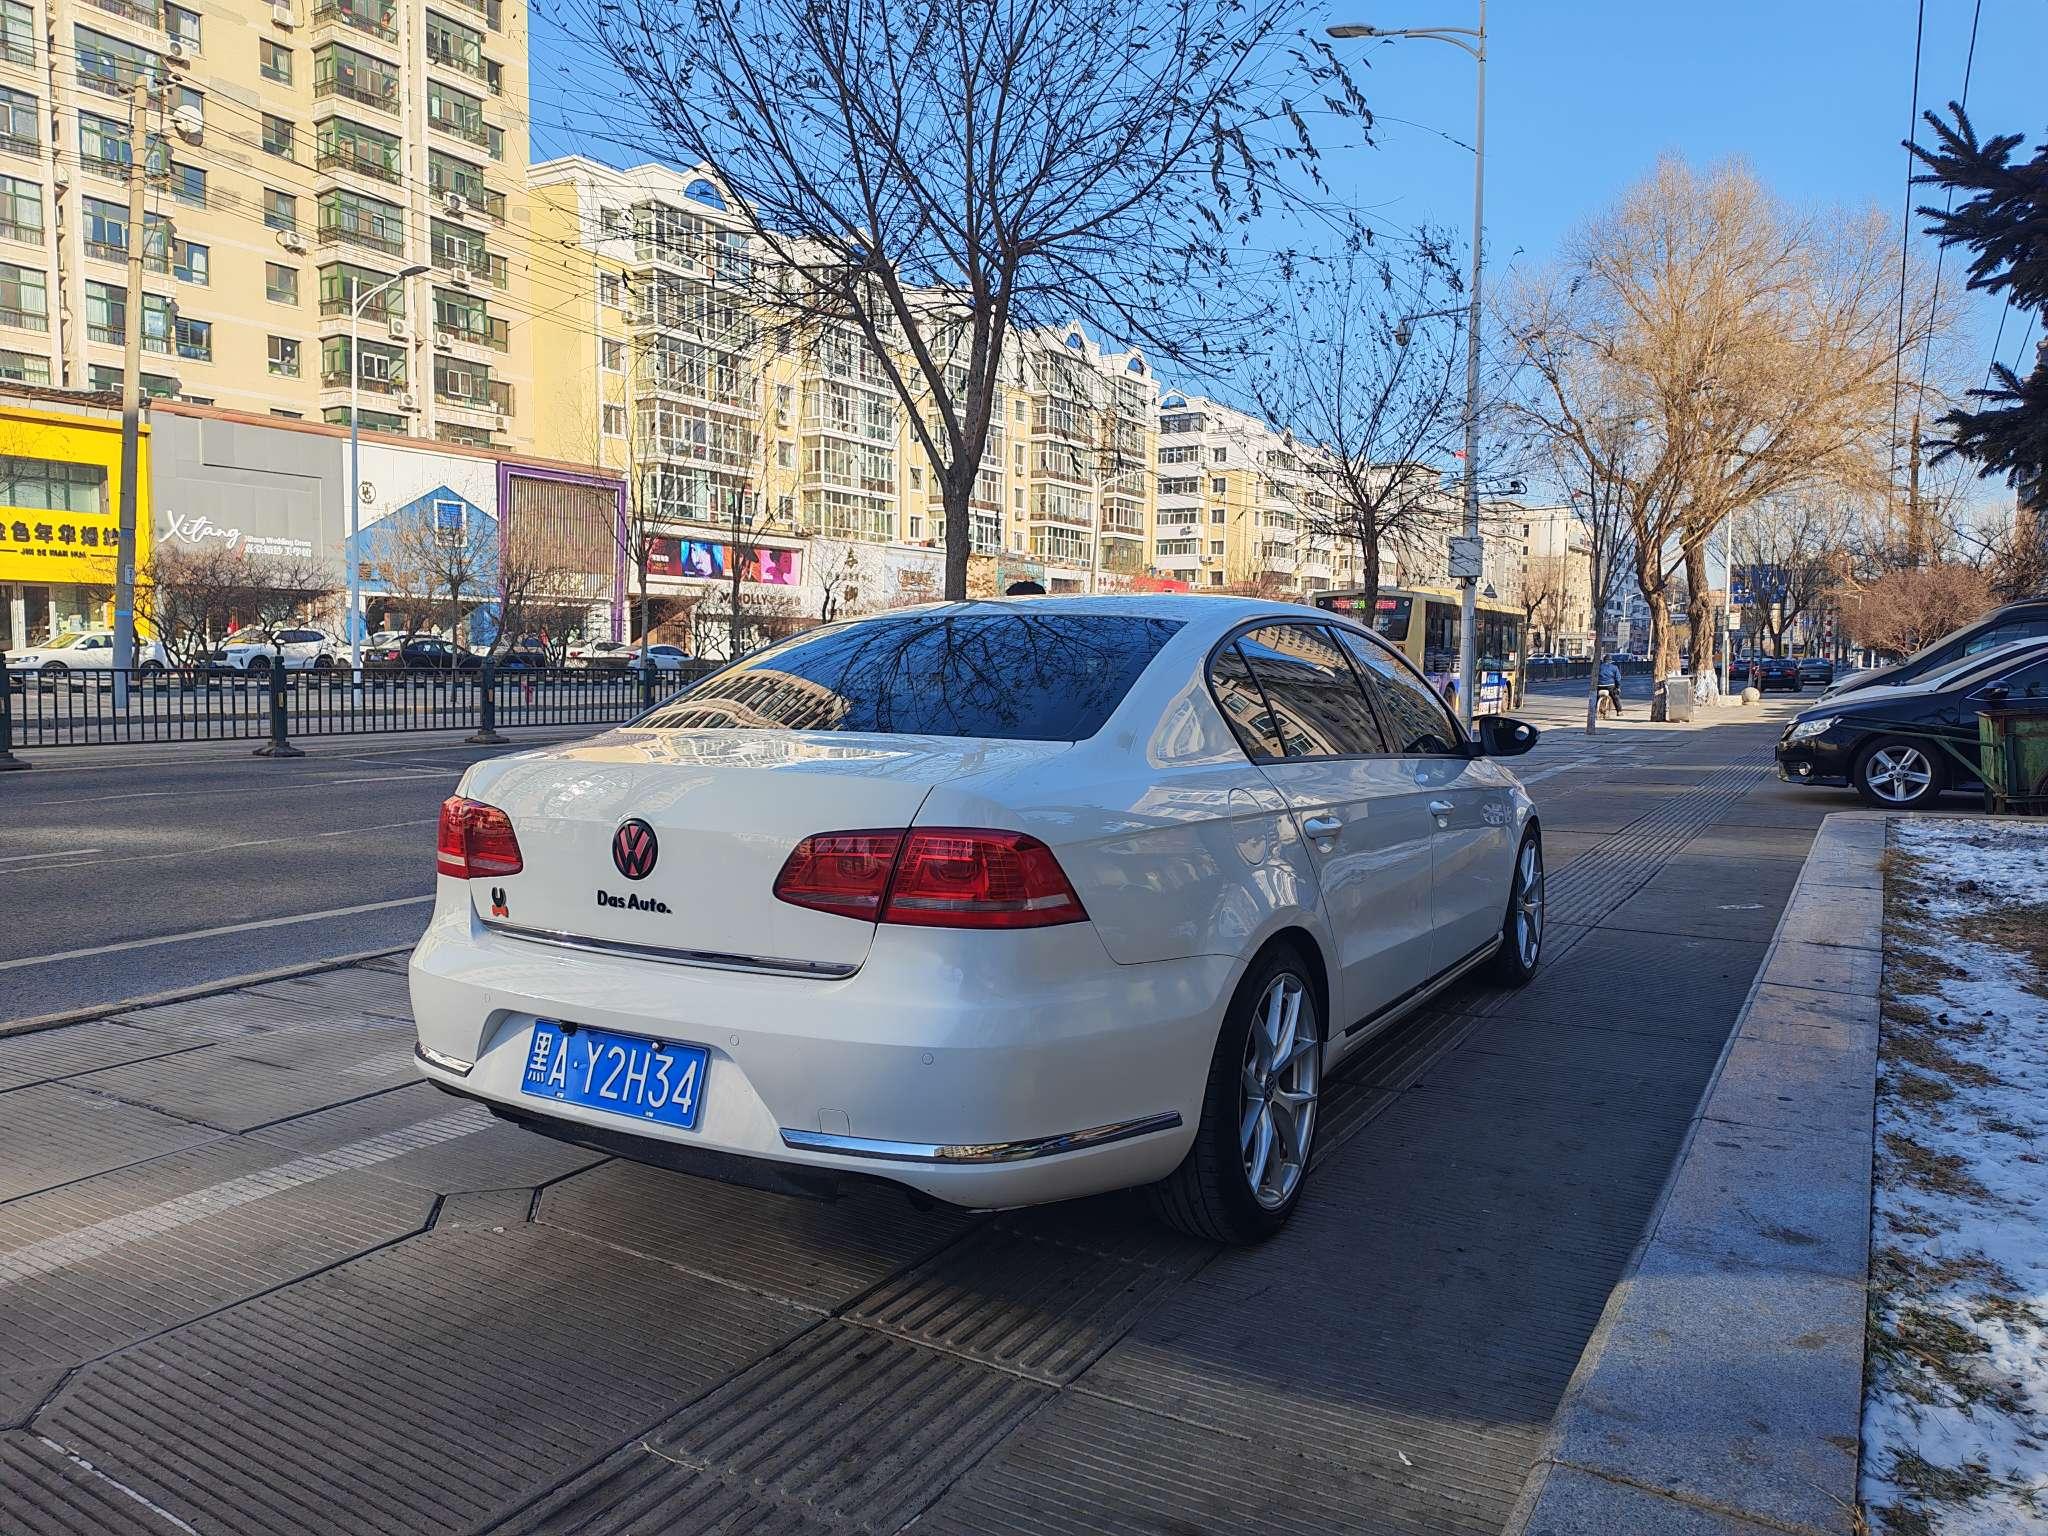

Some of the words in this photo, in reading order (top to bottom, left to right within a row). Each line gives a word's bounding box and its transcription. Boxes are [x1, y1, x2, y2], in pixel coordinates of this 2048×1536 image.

[158, 509, 241, 549] Xitang
[597, 889, 625, 909] Das
[627, 893, 672, 914] Auto.
